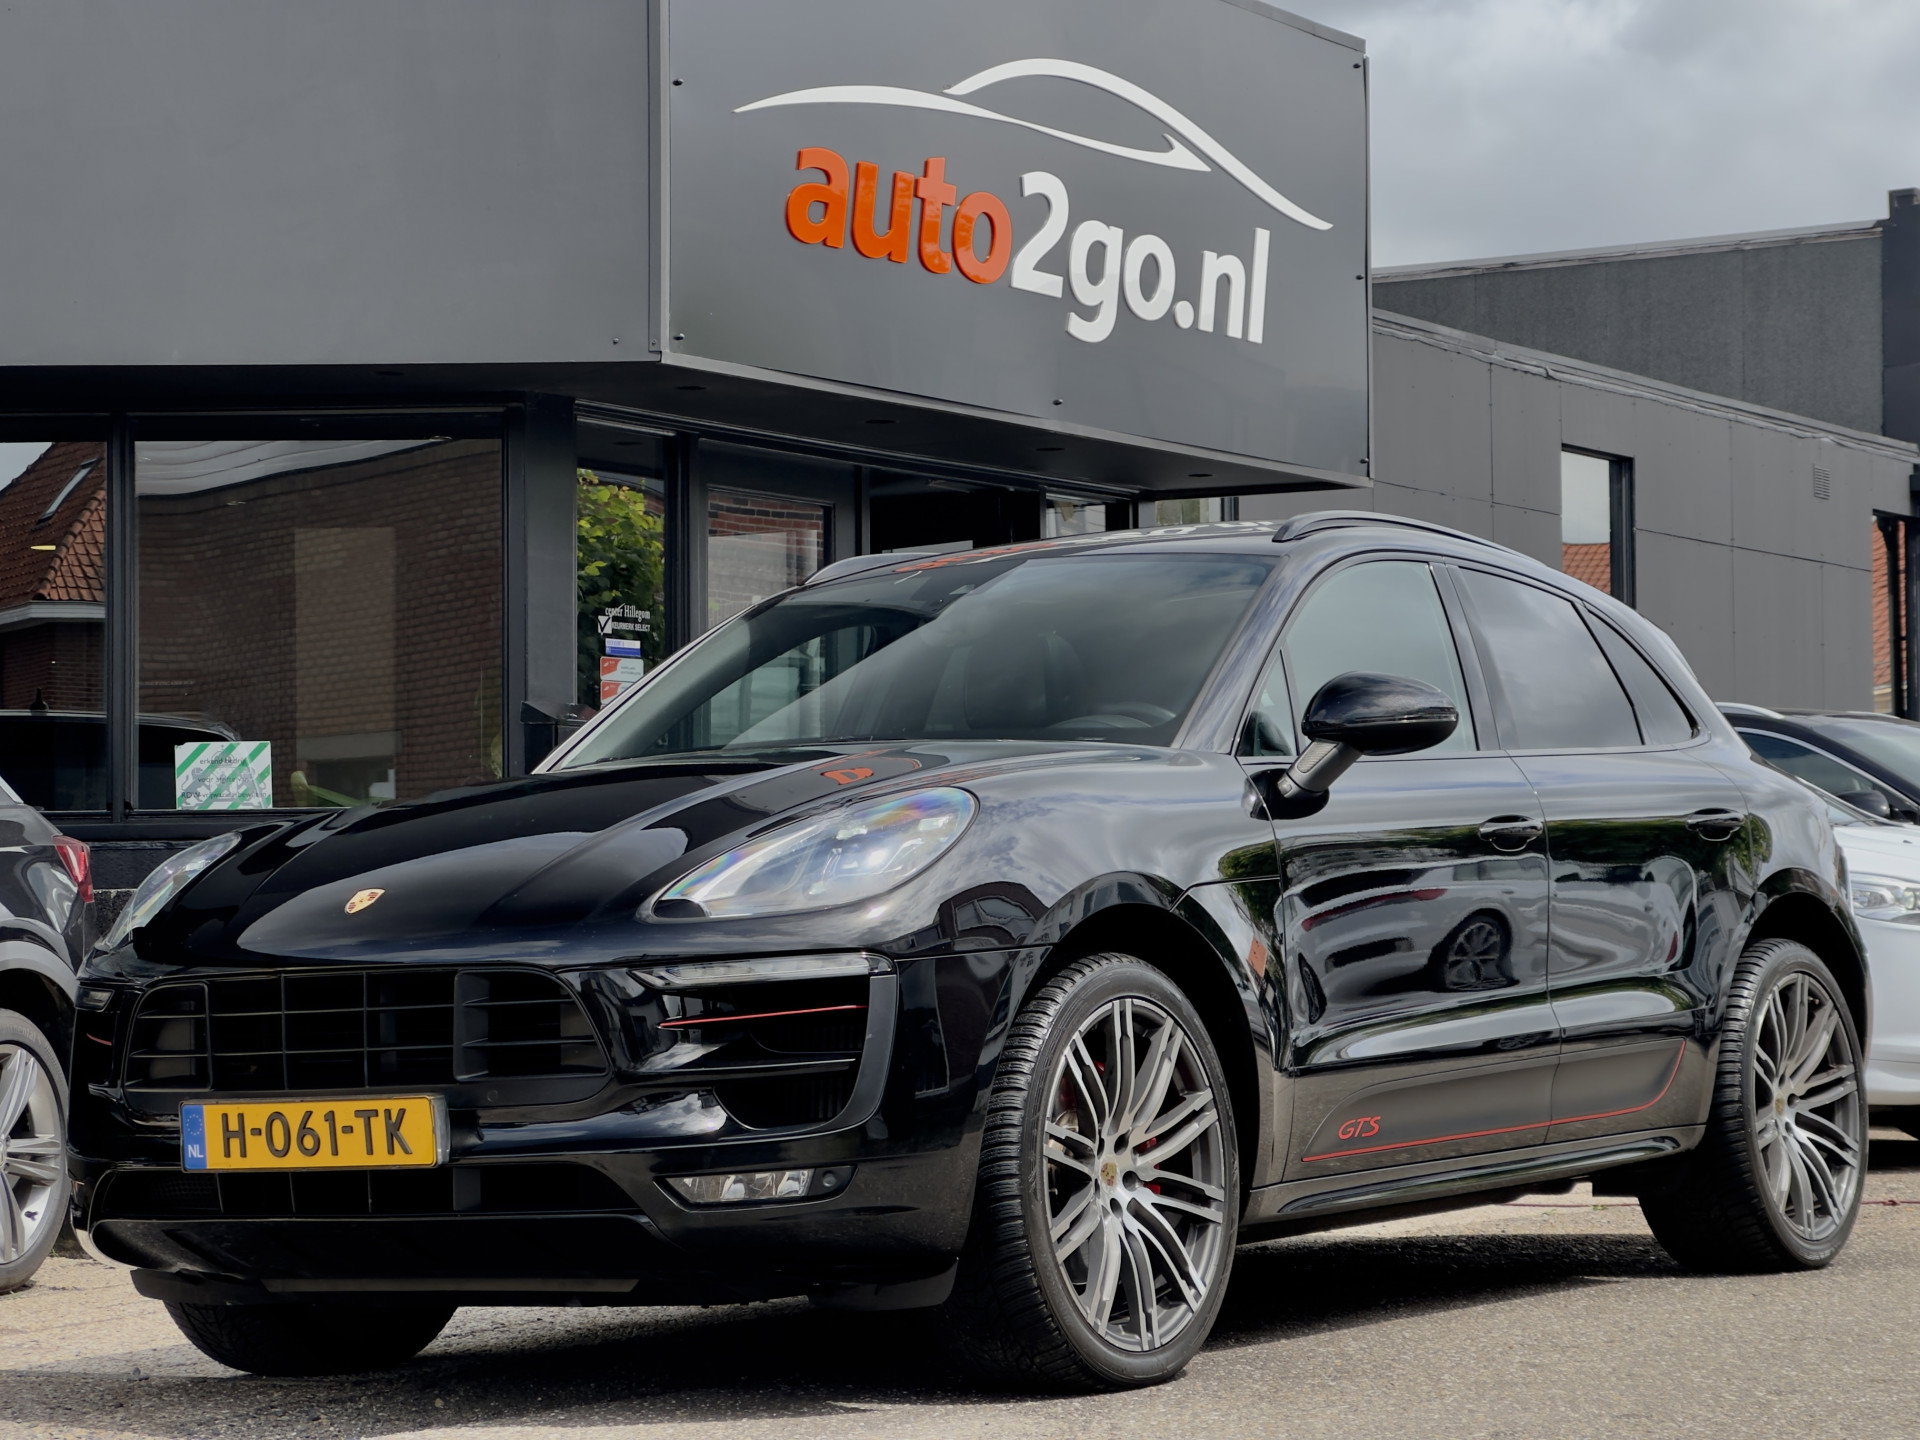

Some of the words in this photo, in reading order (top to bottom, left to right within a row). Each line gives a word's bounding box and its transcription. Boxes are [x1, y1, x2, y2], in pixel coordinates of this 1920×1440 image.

[786, 146, 1270, 344] auto2go.nl
[624, 605, 651, 622] Hillegom
[635, 623, 651, 632] SELECT
[199, 757, 223, 765] erkend
[221, 1108, 413, 1159] H-061-TK
[1338, 1115, 1381, 1140] GTS
[188, 1144, 204, 1159] NL
